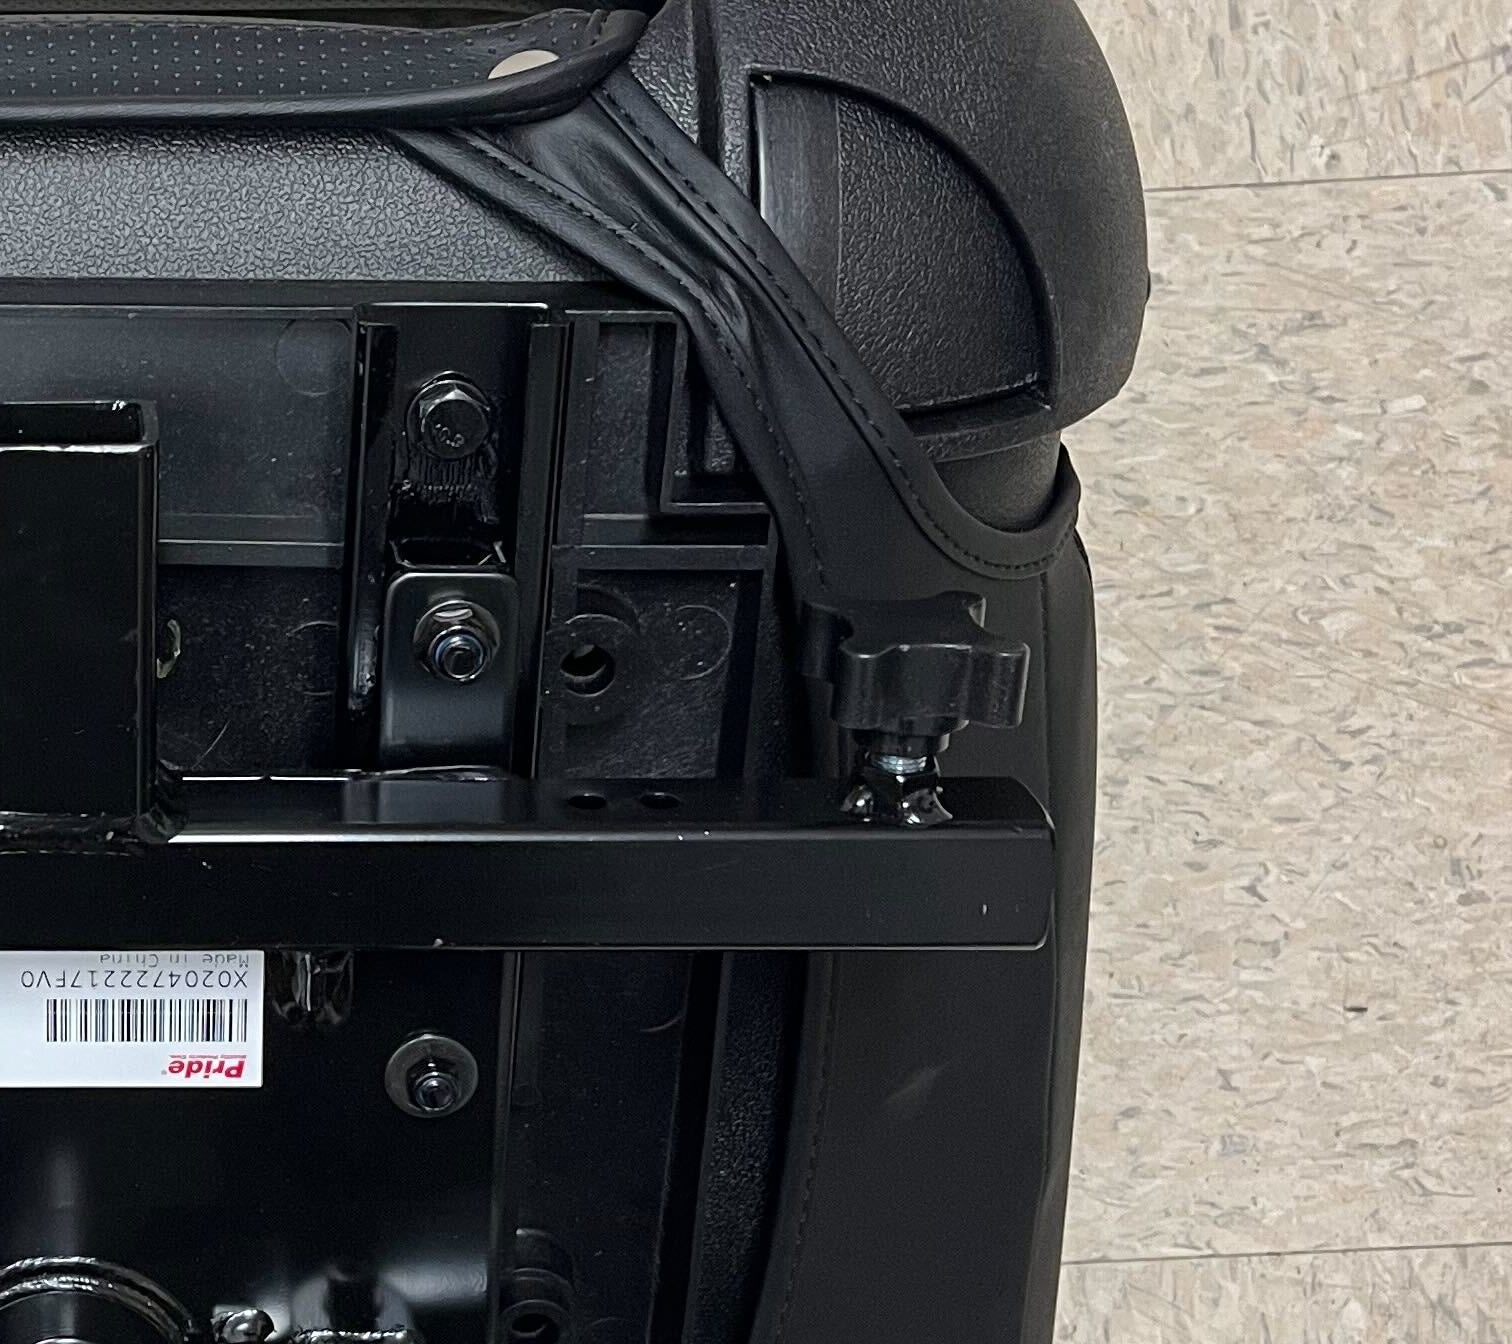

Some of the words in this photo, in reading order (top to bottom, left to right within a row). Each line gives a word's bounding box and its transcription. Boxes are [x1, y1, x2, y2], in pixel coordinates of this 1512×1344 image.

[100, 953, 159, 968] China
[169, 953, 187, 965] in
[202, 953, 249, 969] Made
[21, 970, 248, 988] X0204722217FV0
[168, 1060, 247, 1079] Pride
